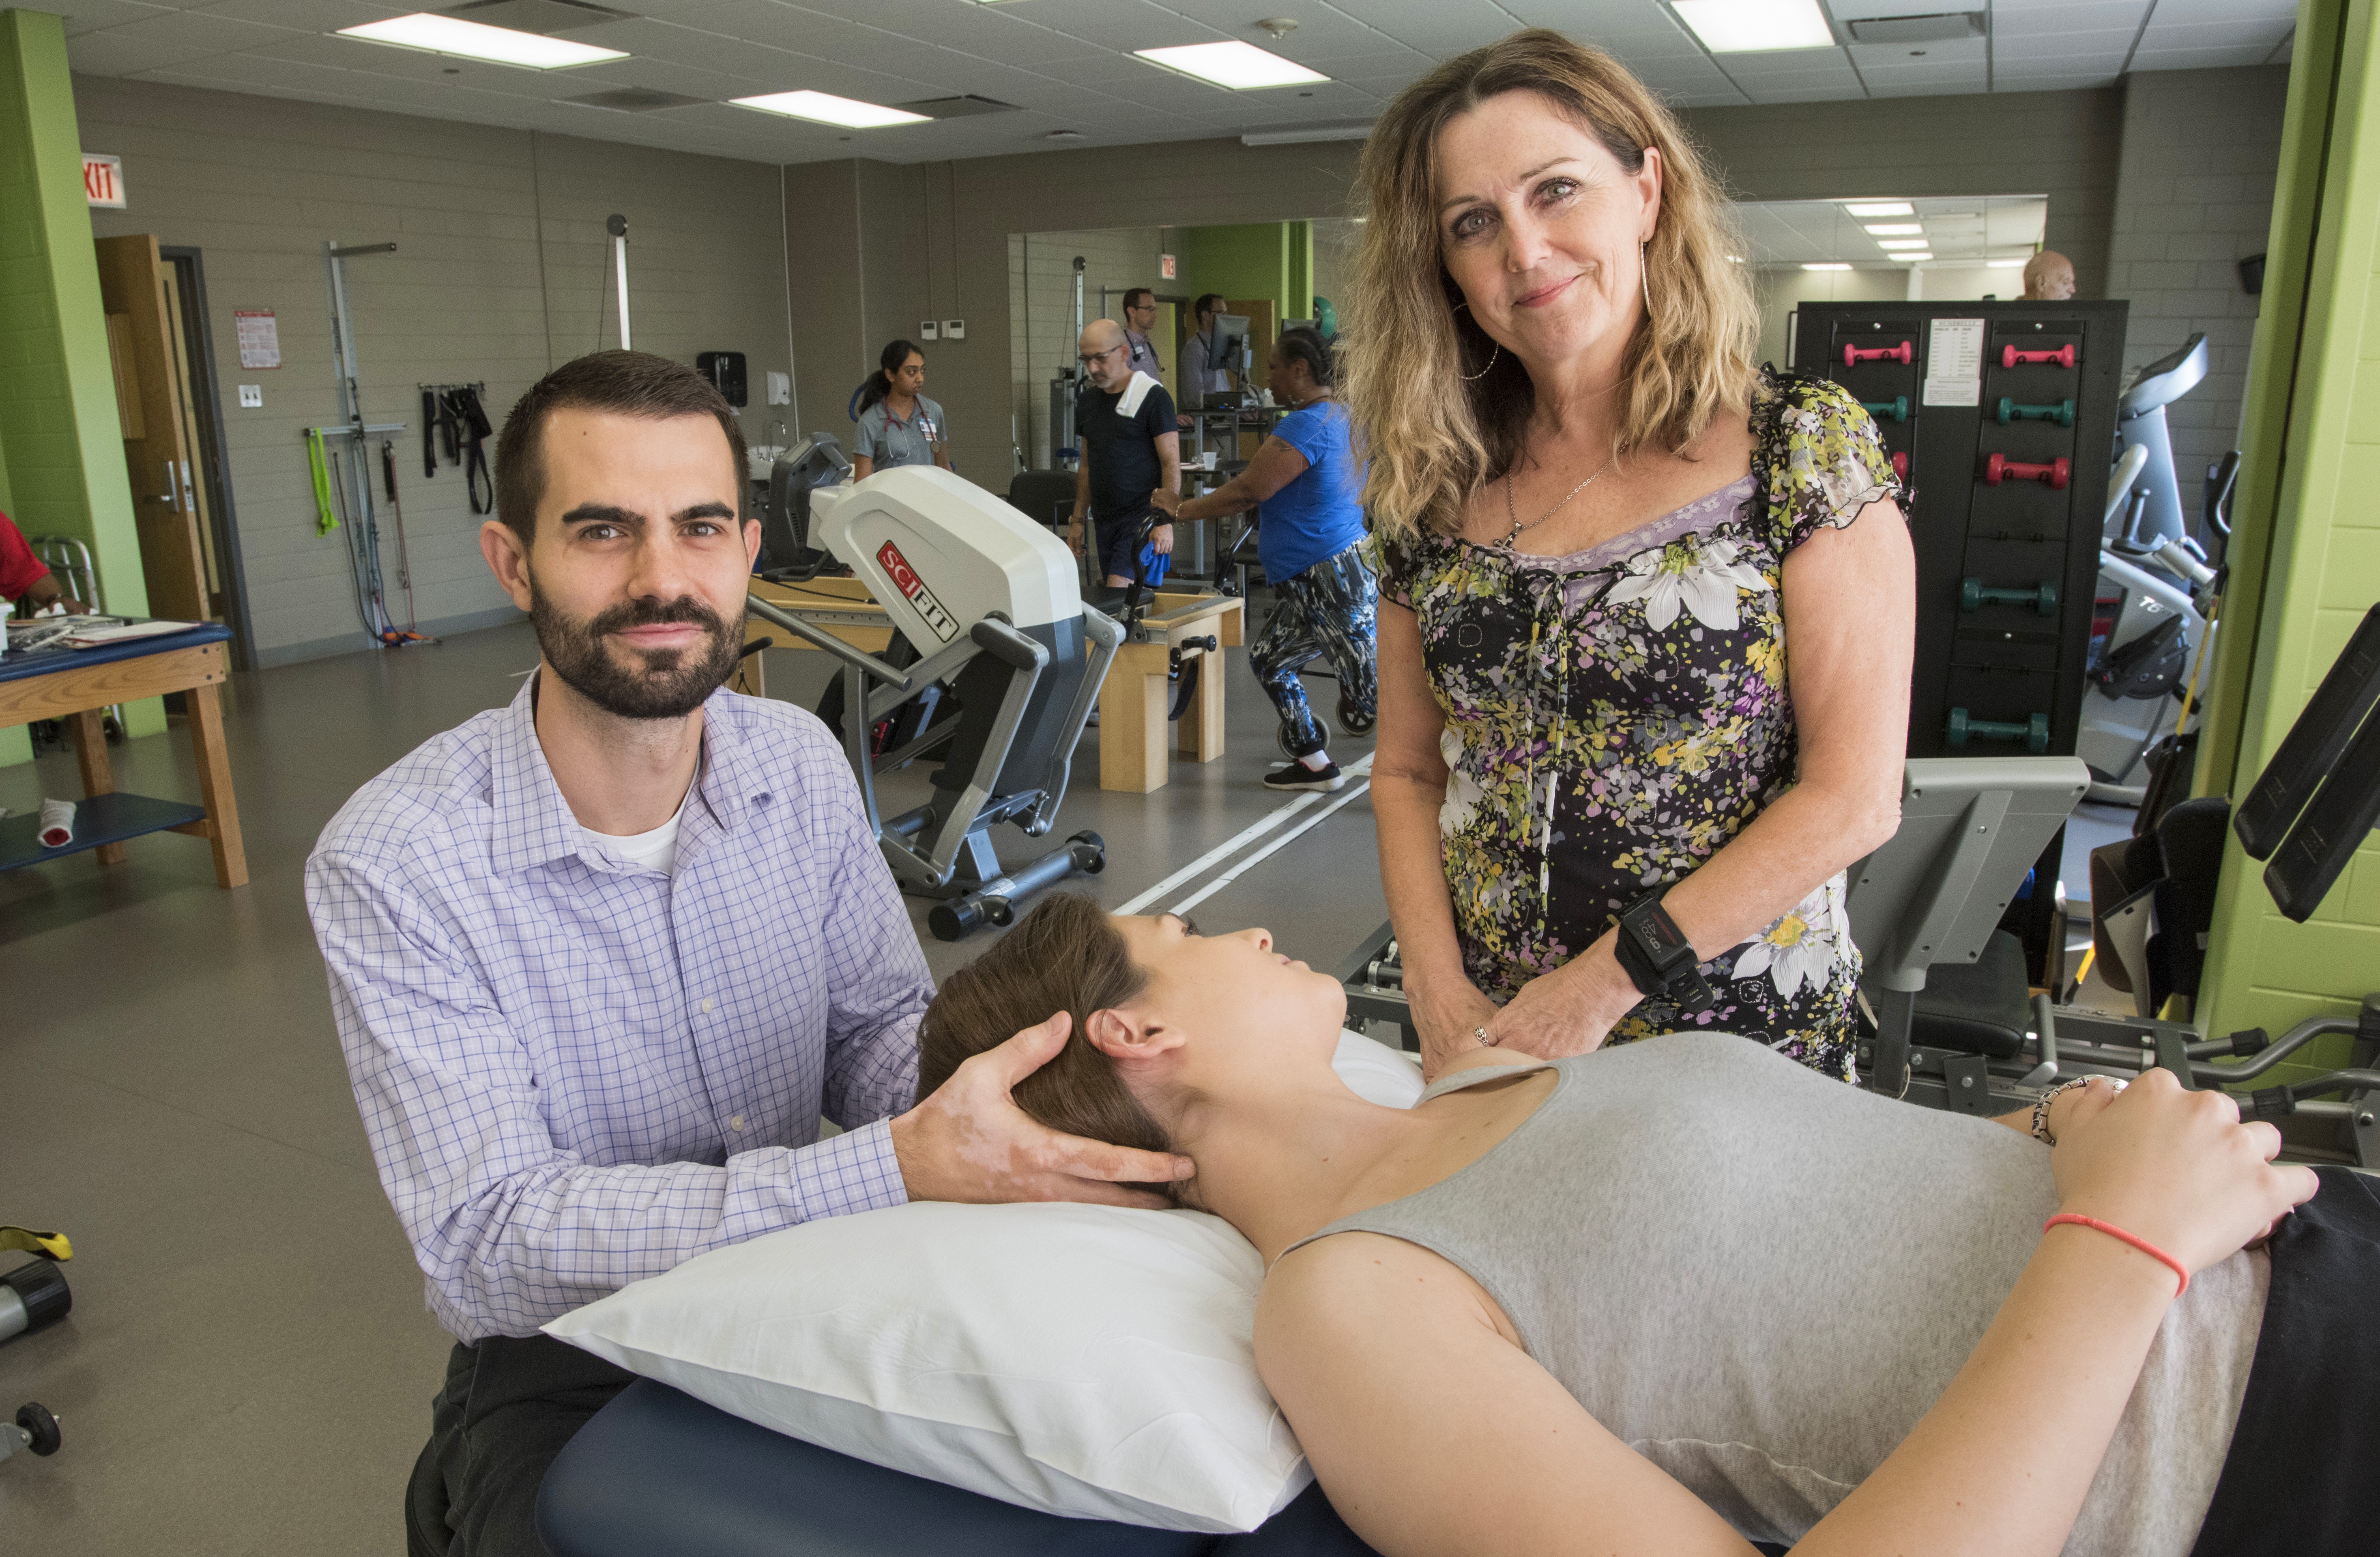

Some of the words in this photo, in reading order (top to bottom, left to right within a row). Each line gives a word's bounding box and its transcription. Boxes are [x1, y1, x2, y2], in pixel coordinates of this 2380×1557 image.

[83, 162, 113, 200] XIT
[882, 550, 952, 631] SCIFIT
[1641, 923, 1656, 939] 48
[1649, 937, 1661, 950] 9
